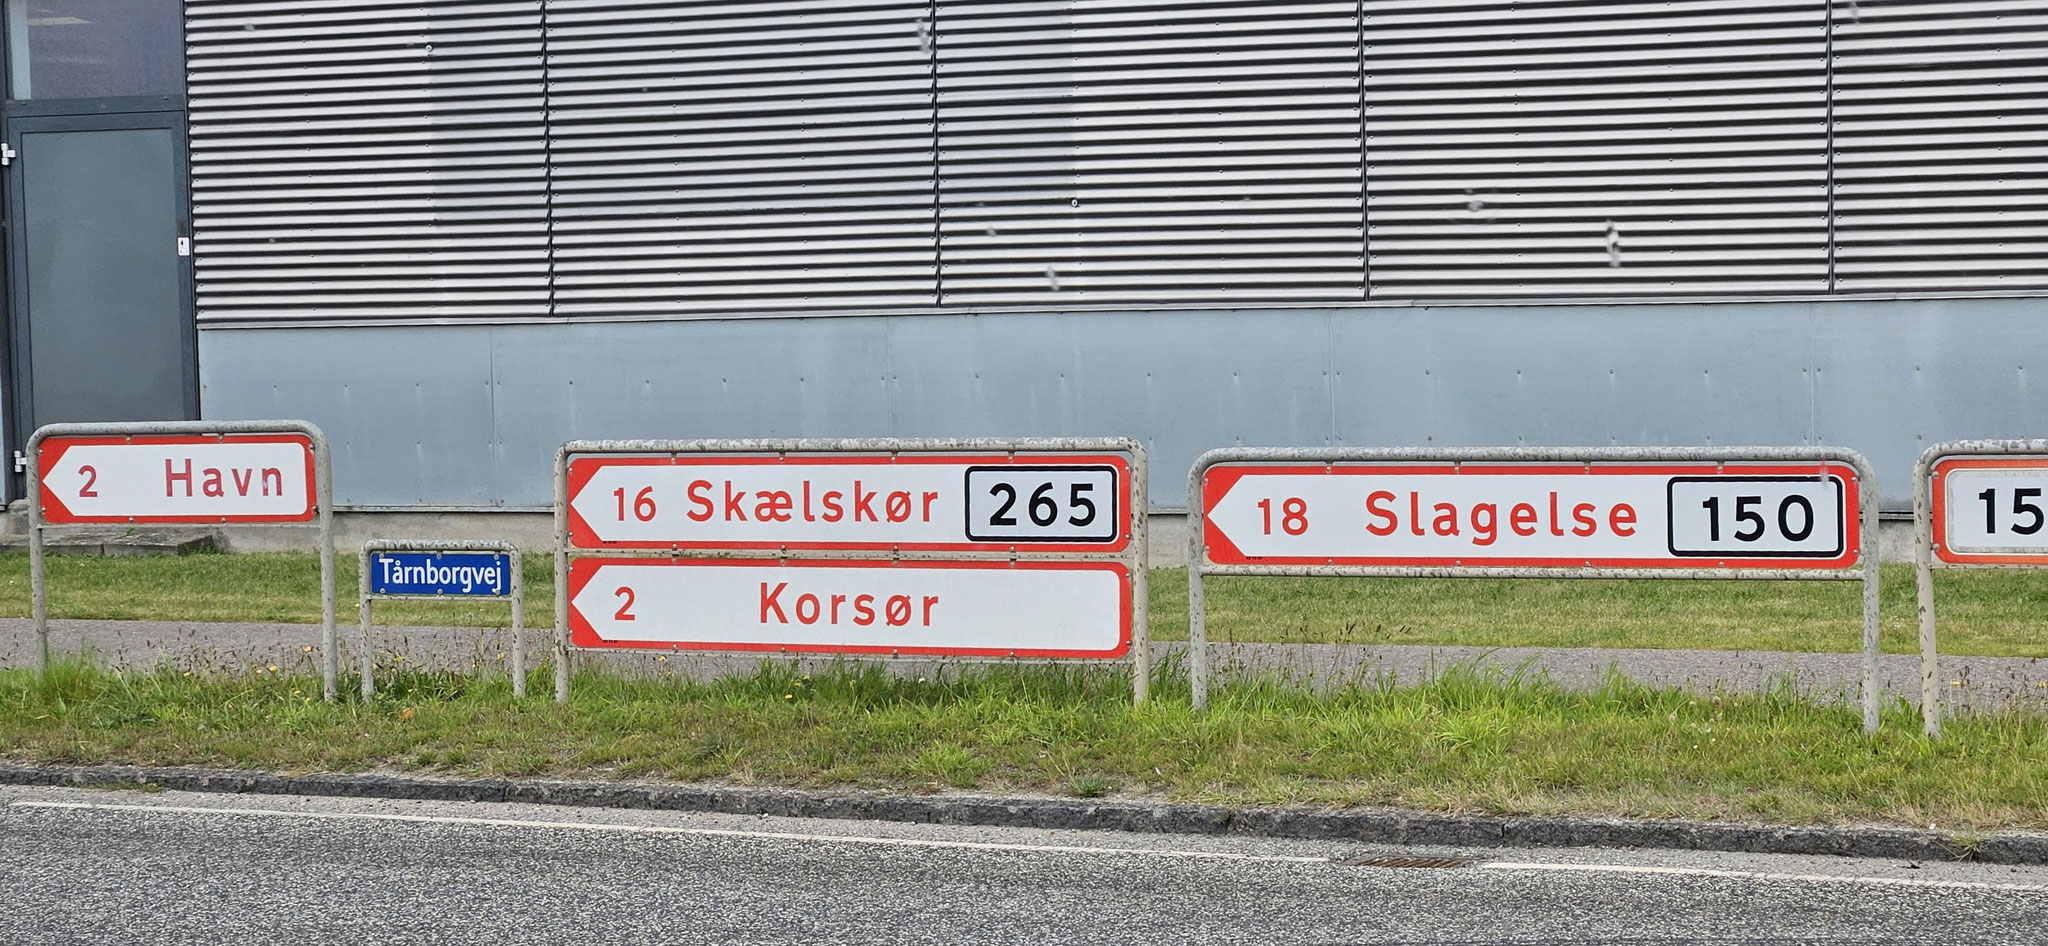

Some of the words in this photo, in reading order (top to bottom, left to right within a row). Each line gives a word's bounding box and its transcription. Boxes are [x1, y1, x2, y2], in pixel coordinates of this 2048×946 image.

[79, 465, 98, 497] 2
[165, 458, 283, 497] Havn
[613, 486, 658, 522] 16
[687, 479, 940, 523] Skælskør
[989, 481, 1097, 527] 265
[1256, 497, 1309, 536] 18
[1365, 490, 1638, 547] Slagelse
[1702, 494, 1814, 542] 150
[378, 558, 502, 593] Tårnborgvej
[614, 586, 636, 621] 2
[760, 582, 940, 627] Korsør
